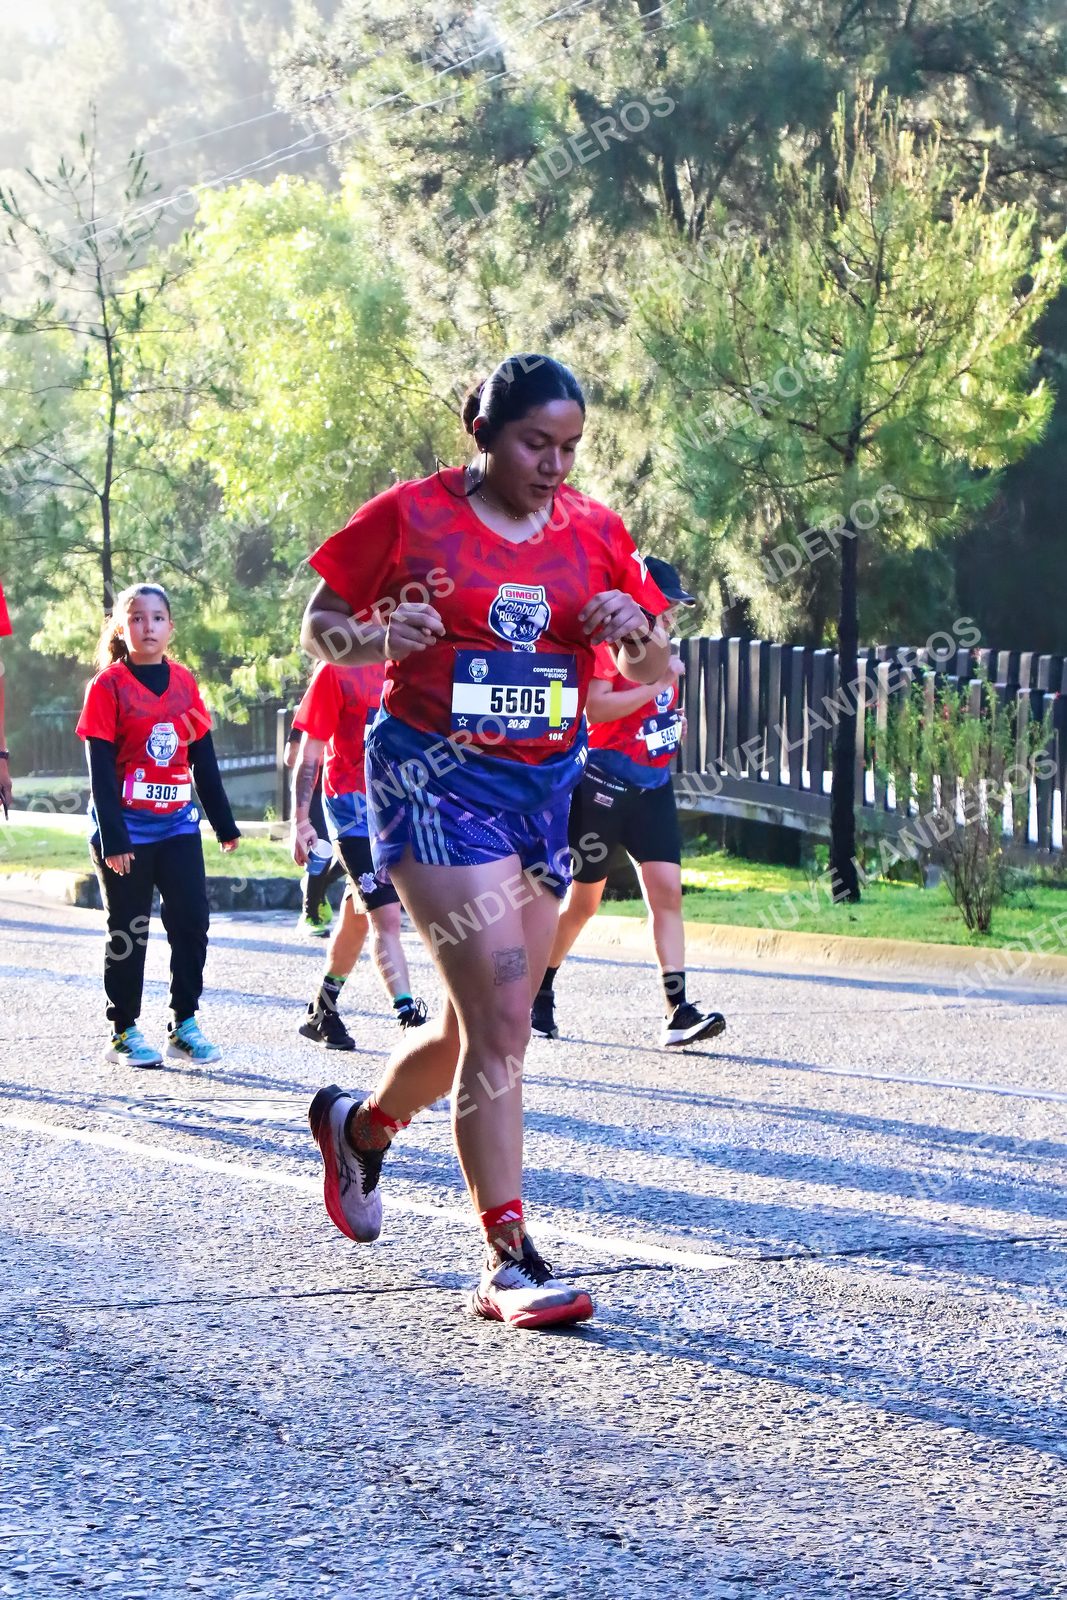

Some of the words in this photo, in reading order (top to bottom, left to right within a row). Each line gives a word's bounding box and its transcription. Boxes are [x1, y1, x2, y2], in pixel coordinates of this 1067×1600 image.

[505, 590, 539, 600] BIMBO
[505, 602, 539, 616] Global
[498, 611, 522, 622] Race
[490, 687, 546, 714] 5505
[548, 732, 564, 741] 10K
[146, 784, 178, 800] 3303
